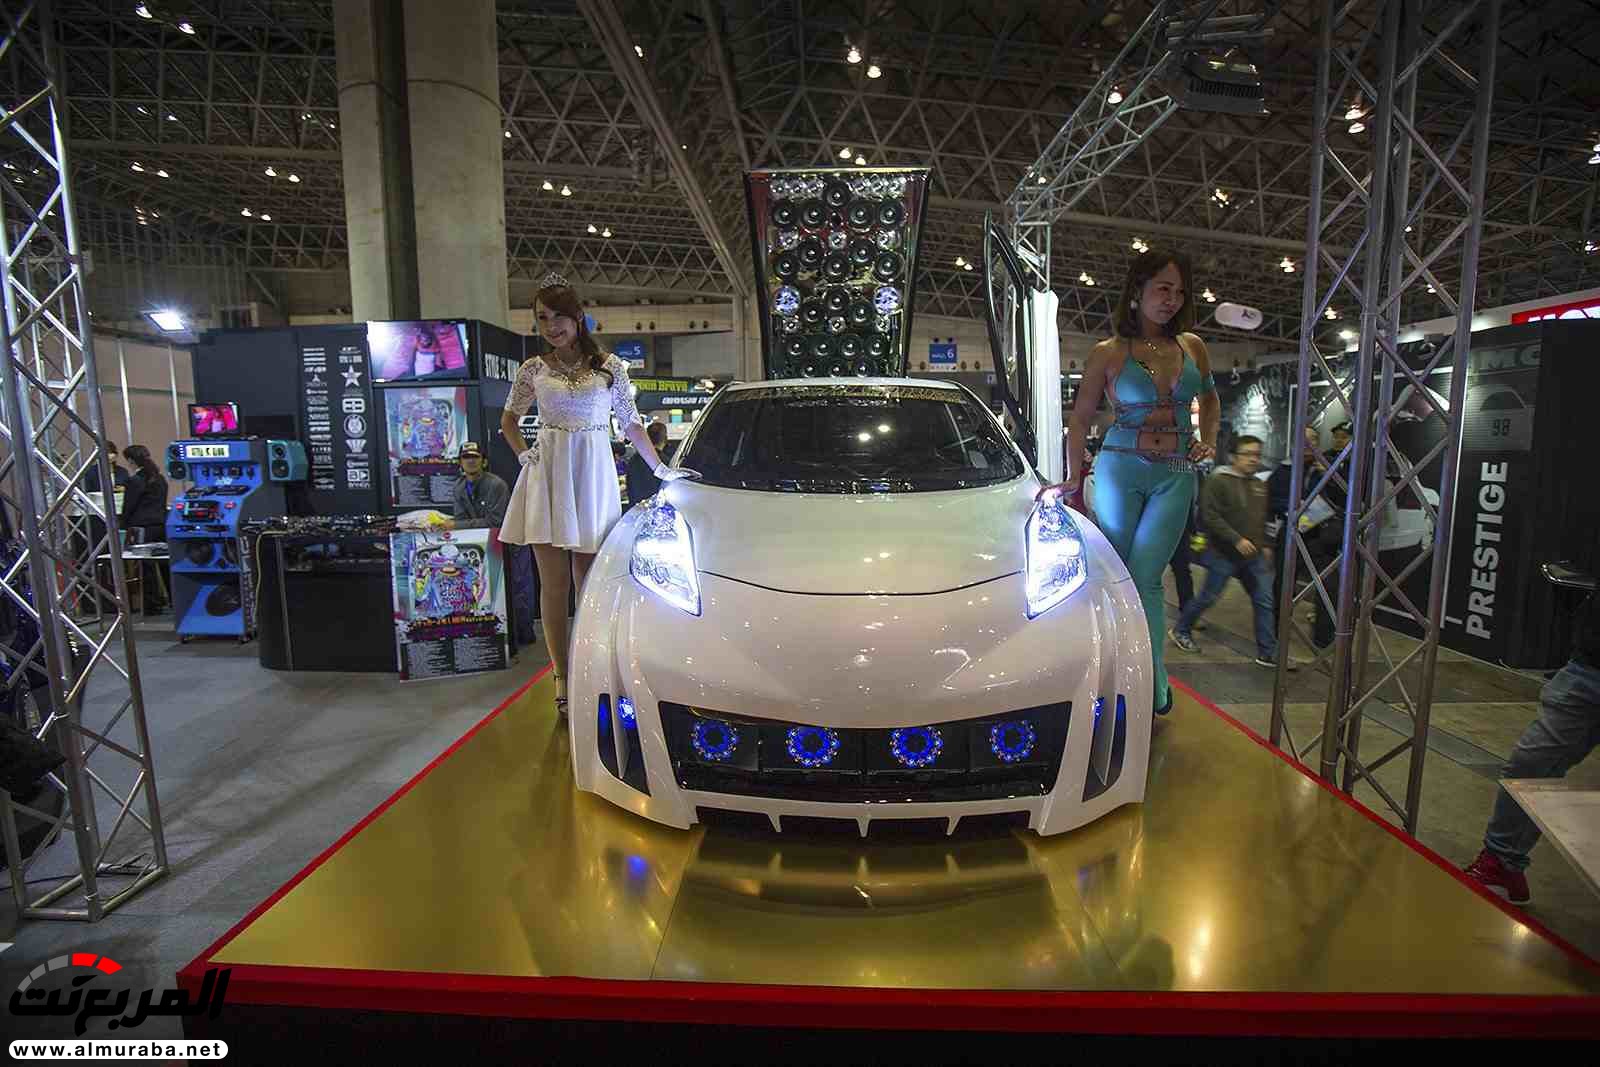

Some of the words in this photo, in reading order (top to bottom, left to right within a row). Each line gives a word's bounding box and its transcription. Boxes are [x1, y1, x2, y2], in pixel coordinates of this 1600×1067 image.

[633, 345, 641, 356] 5
[947, 349, 954, 359] 6
[1465, 462, 1509, 640] PRESTIGE
